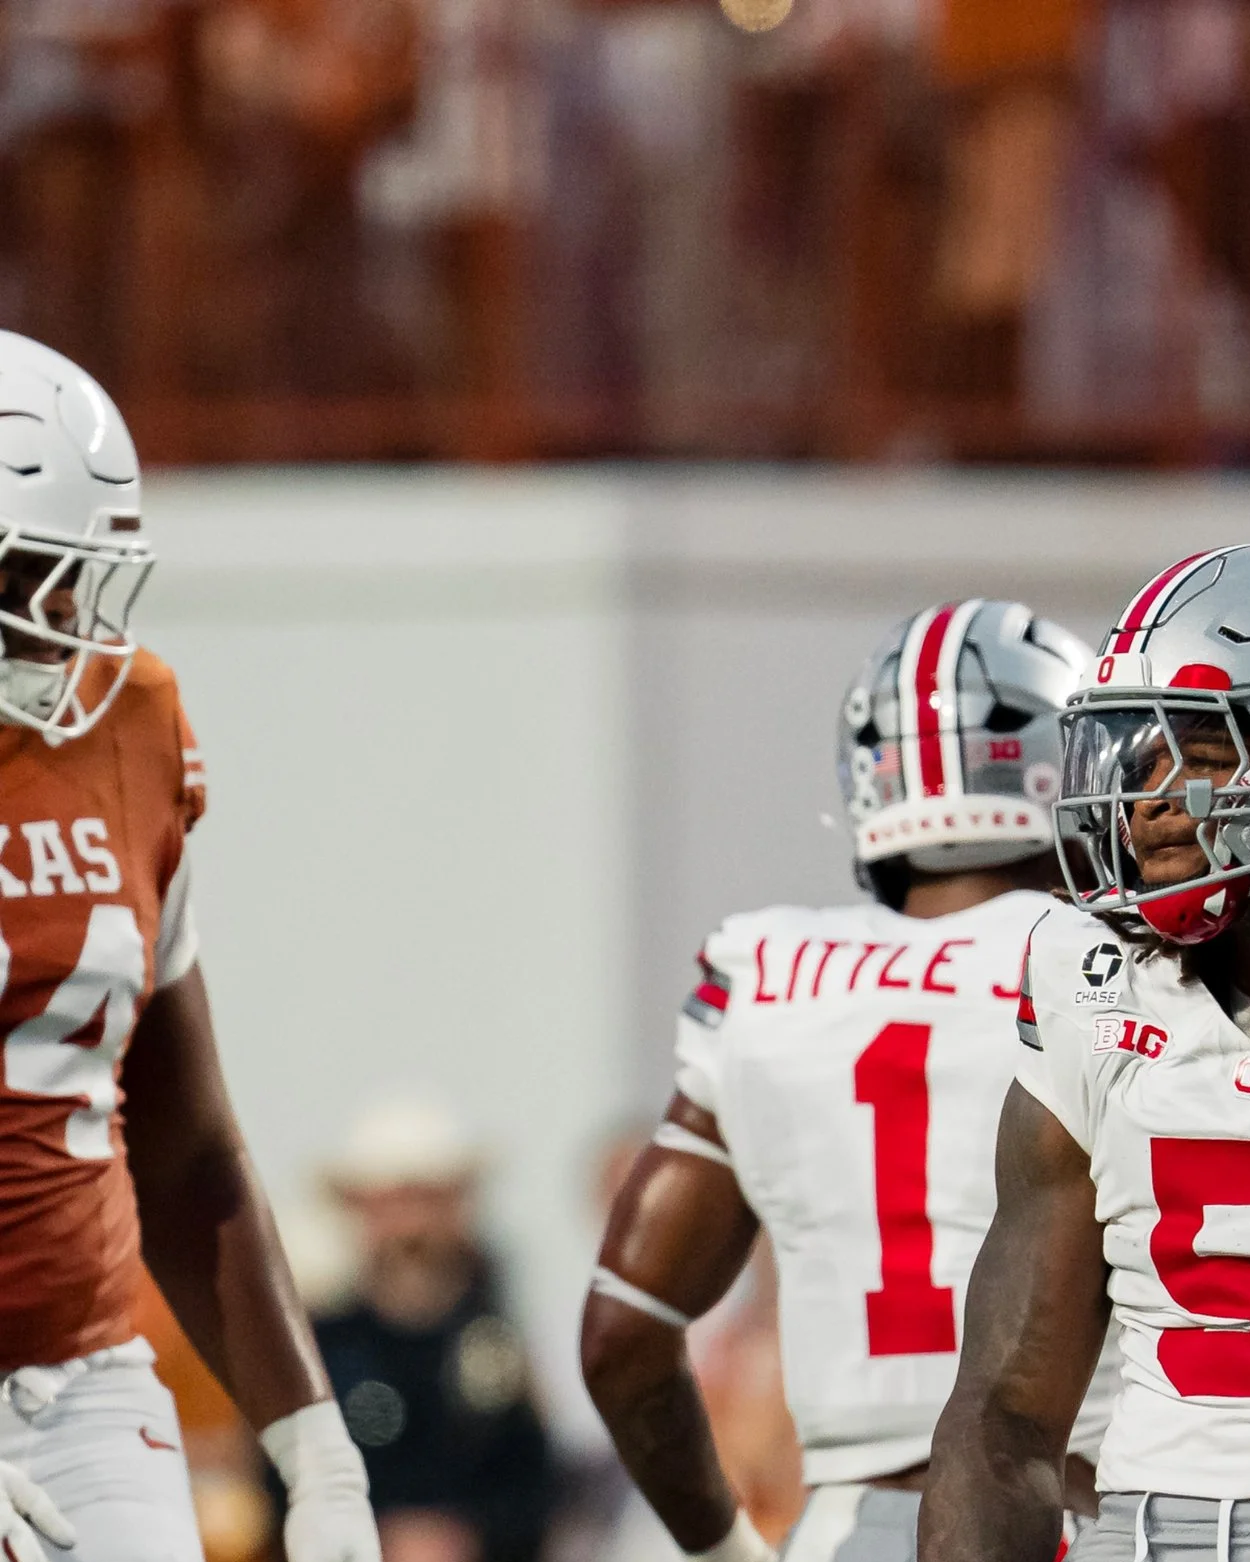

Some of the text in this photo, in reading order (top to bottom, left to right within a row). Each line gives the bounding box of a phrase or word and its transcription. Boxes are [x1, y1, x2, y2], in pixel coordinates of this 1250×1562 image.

[753, 937, 976, 1004] LITTLE
[1074, 990, 1118, 1005] CHASE
[853, 1021, 957, 1358] 1
